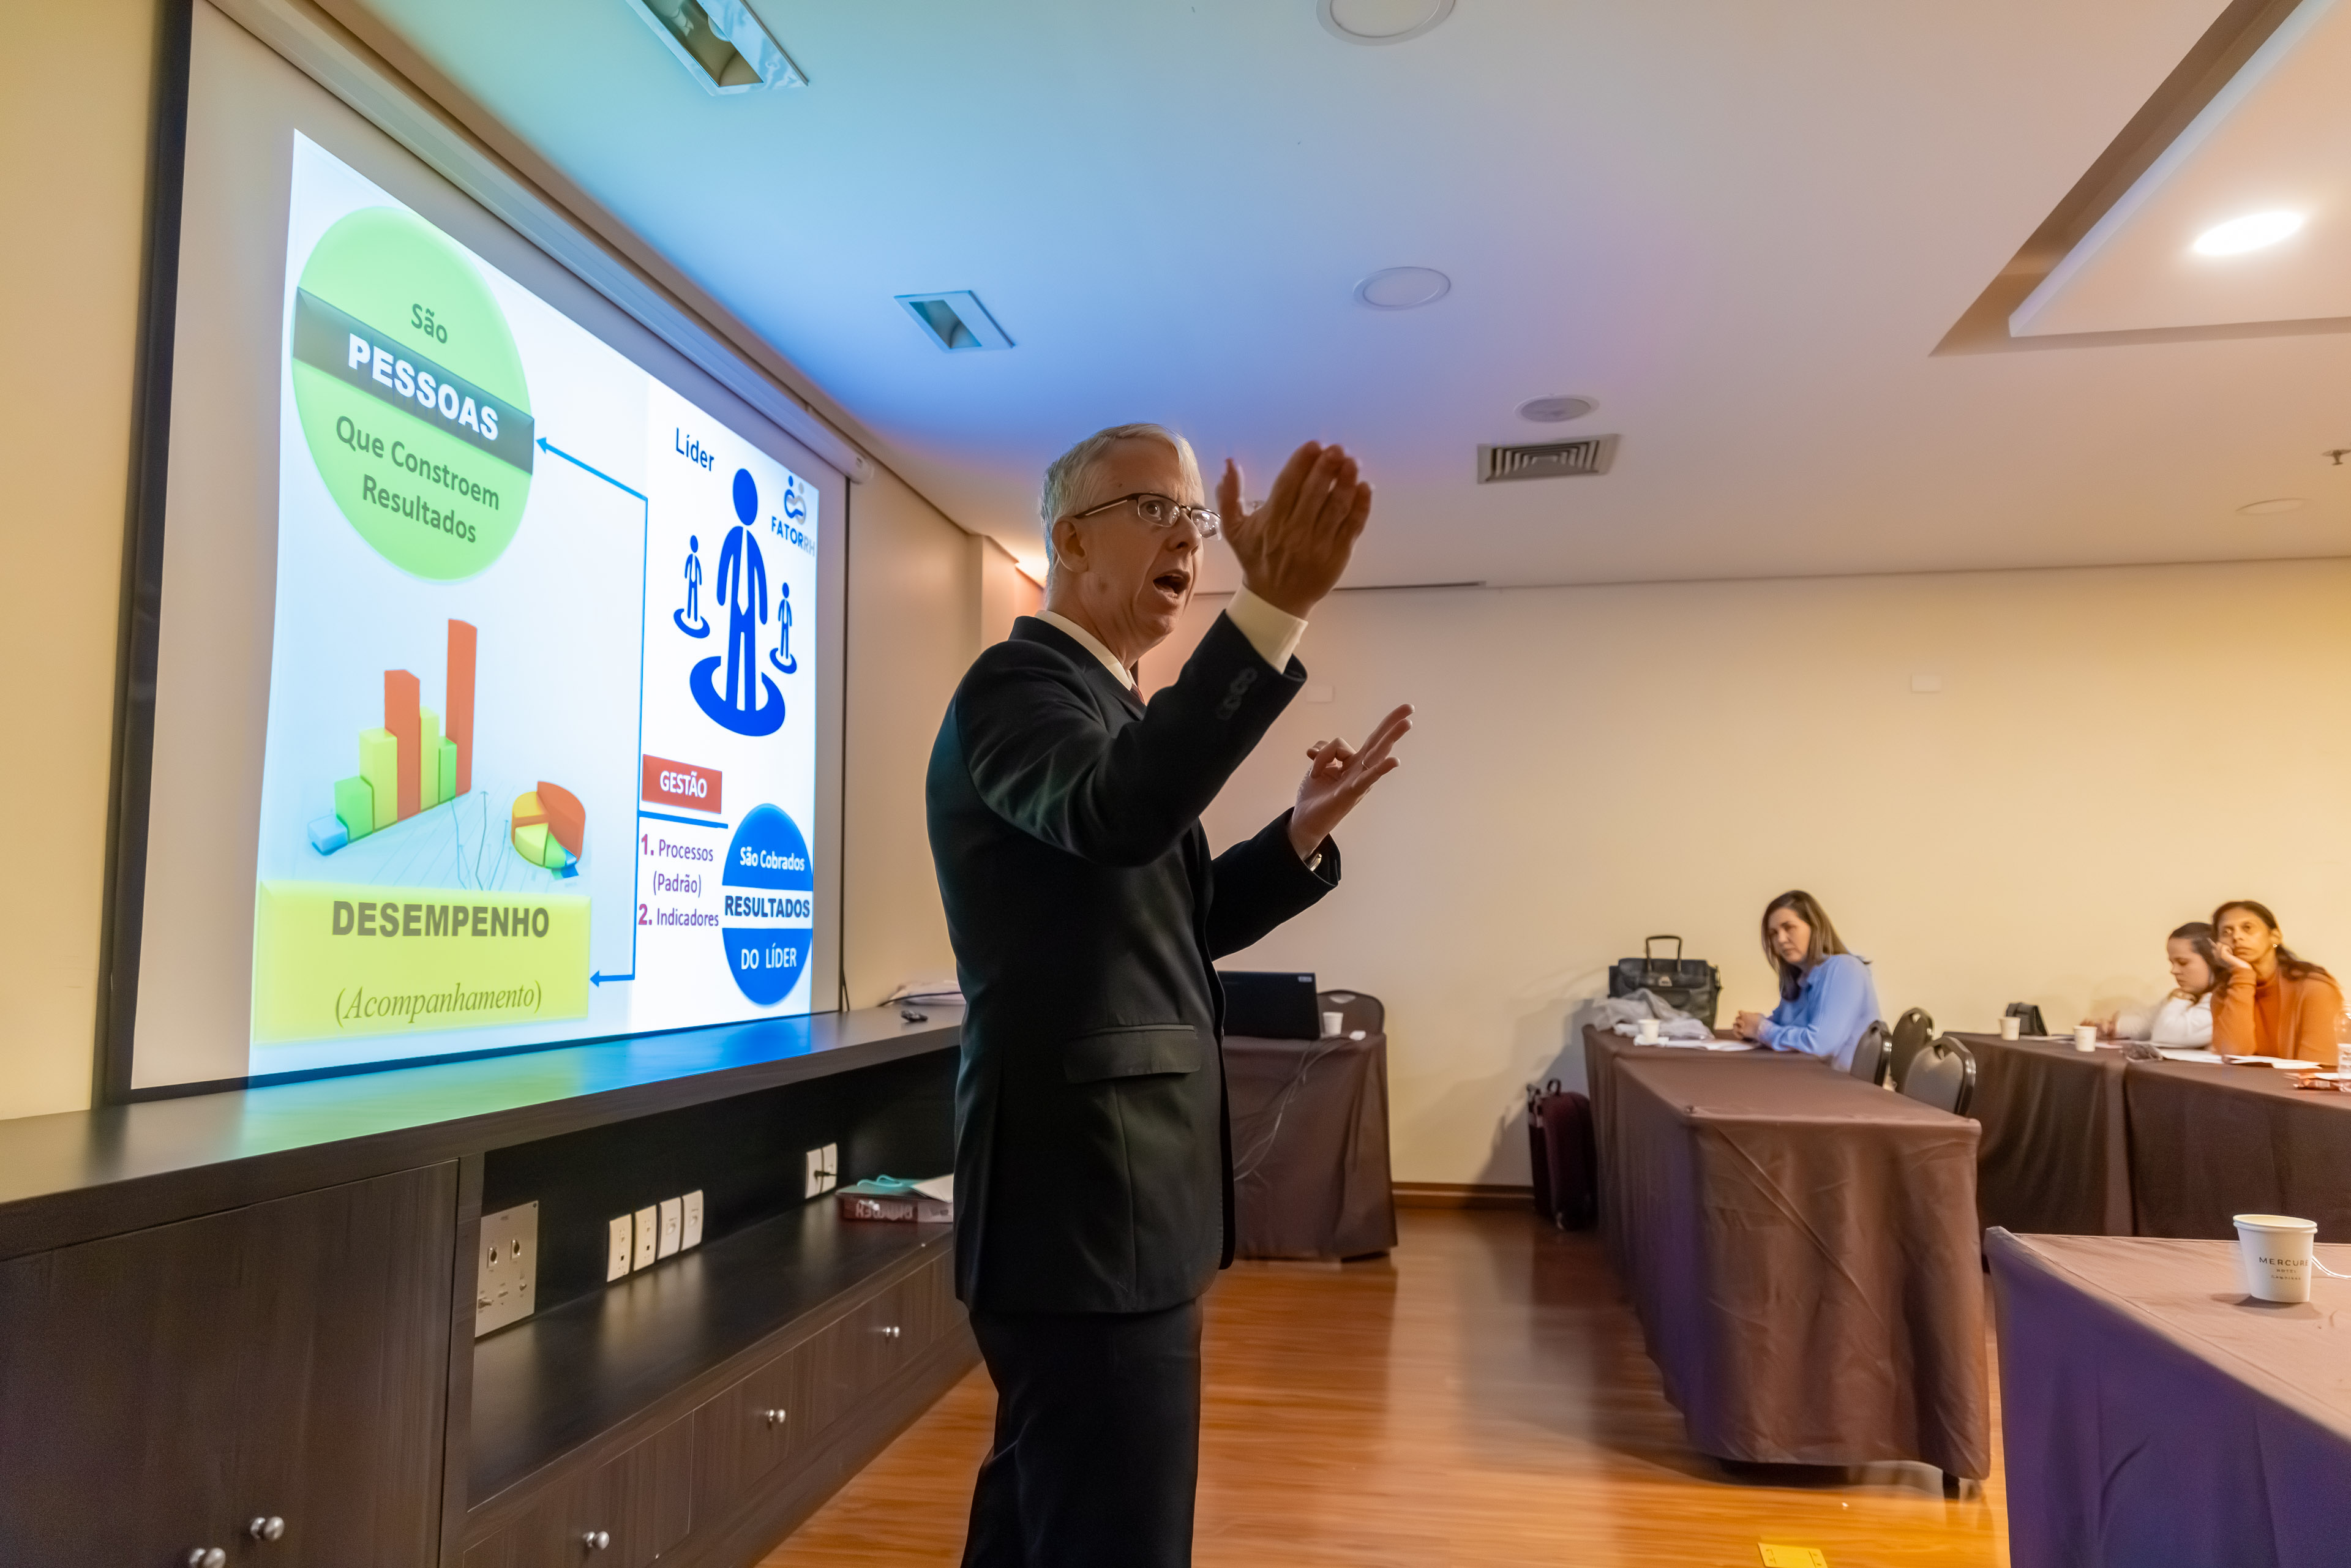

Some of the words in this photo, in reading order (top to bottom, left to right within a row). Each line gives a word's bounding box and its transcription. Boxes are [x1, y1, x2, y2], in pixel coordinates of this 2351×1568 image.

[411, 303, 448, 344] São
[348, 332, 499, 441] PESSOAS
[336, 415, 384, 459] Que
[391, 441, 500, 510] Constroem
[675, 427, 715, 472] Líder
[362, 474, 478, 543] Resultados
[771, 516, 816, 558] FATORRH
[659, 771, 708, 798] GESTÃO
[640, 834, 654, 856] 1.
[658, 839, 714, 862] Processos
[740, 846, 758, 868] São
[760, 849, 805, 872] Cobrados
[653, 870, 702, 898] (Padrão)
[332, 900, 549, 938] DESEMPENHO
[638, 903, 653, 926] 2.
[656, 907, 719, 927] Indicadores
[724, 895, 811, 918] RESULTADOS
[741, 948, 759, 970] DO
[765, 942, 797, 969] LÍDER
[335, 980, 542, 1029] (Acompanhamento)
[2259, 1257, 2308, 1266] MERCURE
